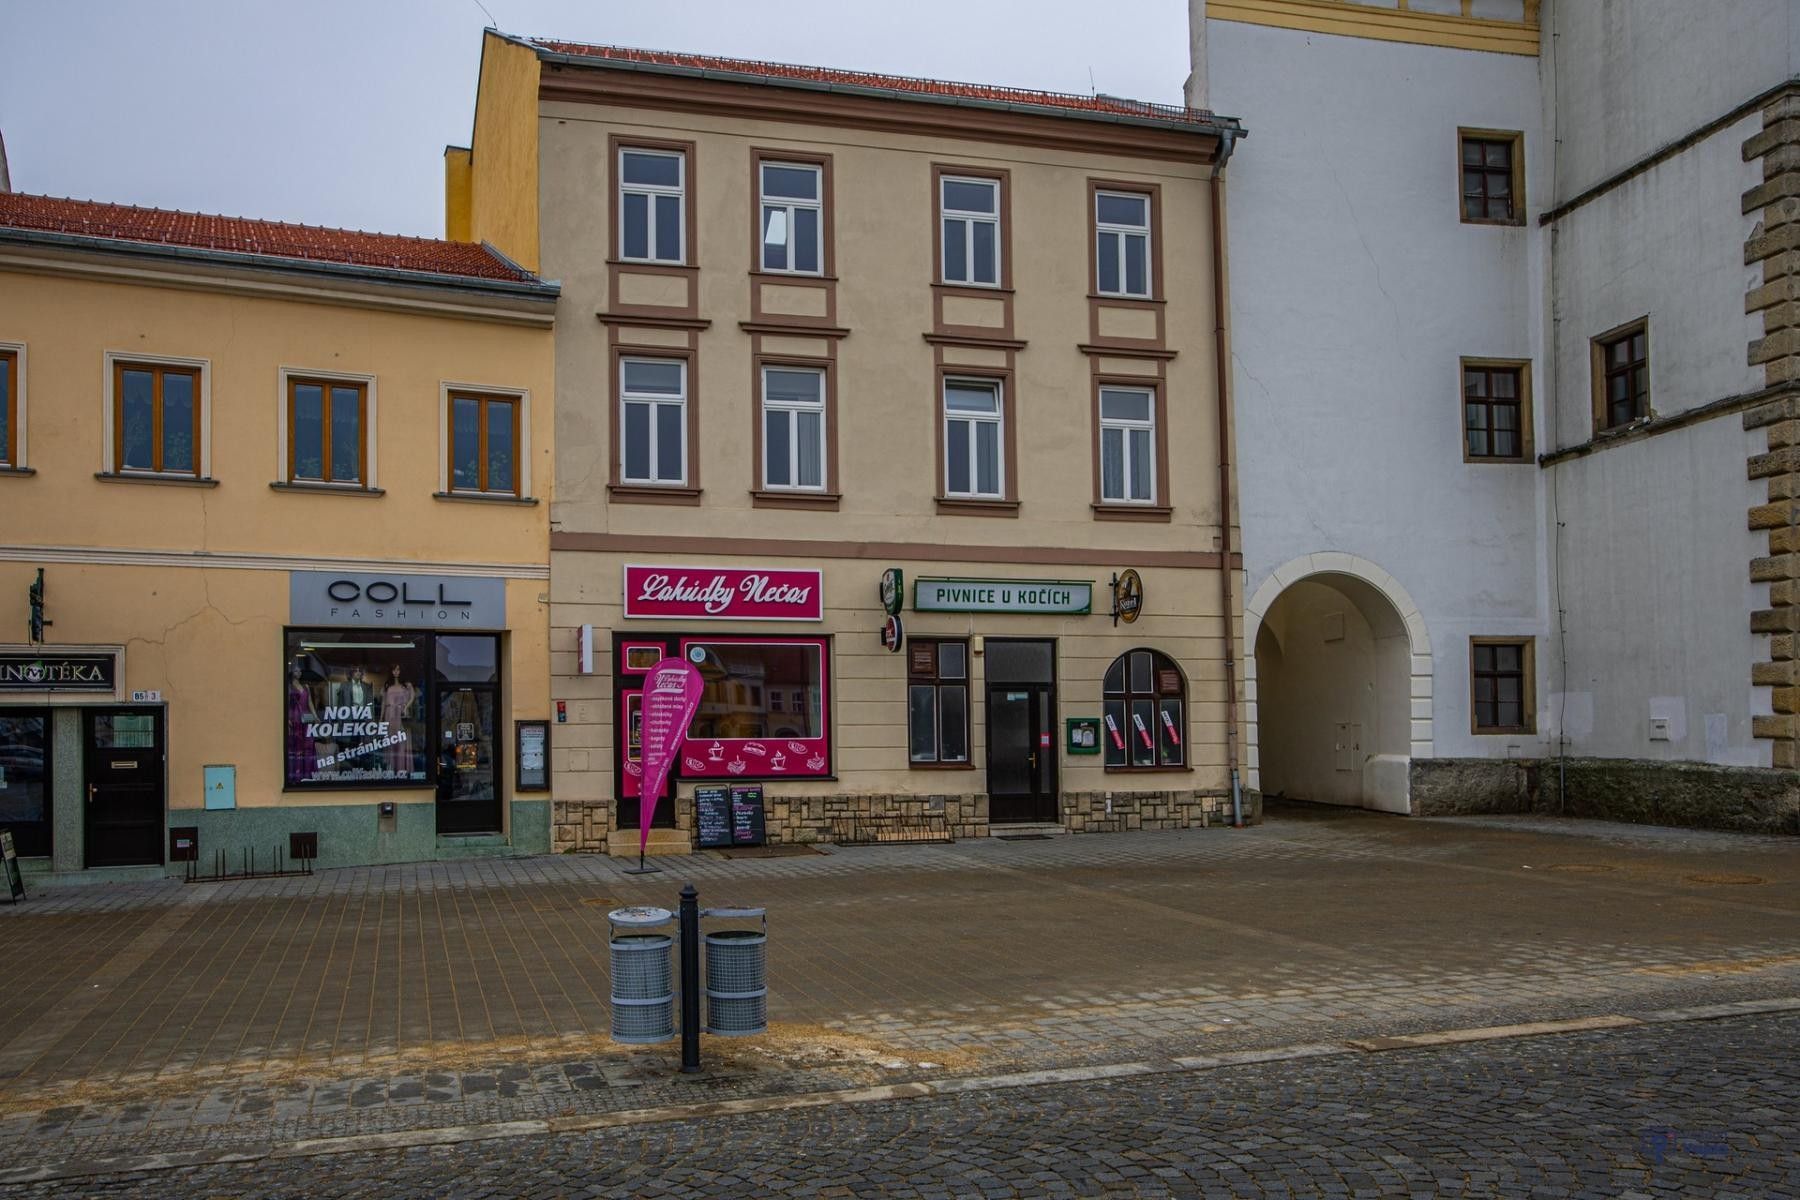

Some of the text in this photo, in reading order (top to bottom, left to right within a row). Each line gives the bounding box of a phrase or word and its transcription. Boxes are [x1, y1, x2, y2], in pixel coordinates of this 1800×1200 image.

[328, 580, 472, 605] COLL
[739, 574, 812, 604] Nečas
[936, 586, 1071, 606] PIVNICE U KOČÍCH
[330, 607, 471, 620] FASHION
[323, 702, 373, 720] NOVÁ
[306, 721, 390, 738] KOLEKCE
[316, 729, 407, 769] na stránkách
